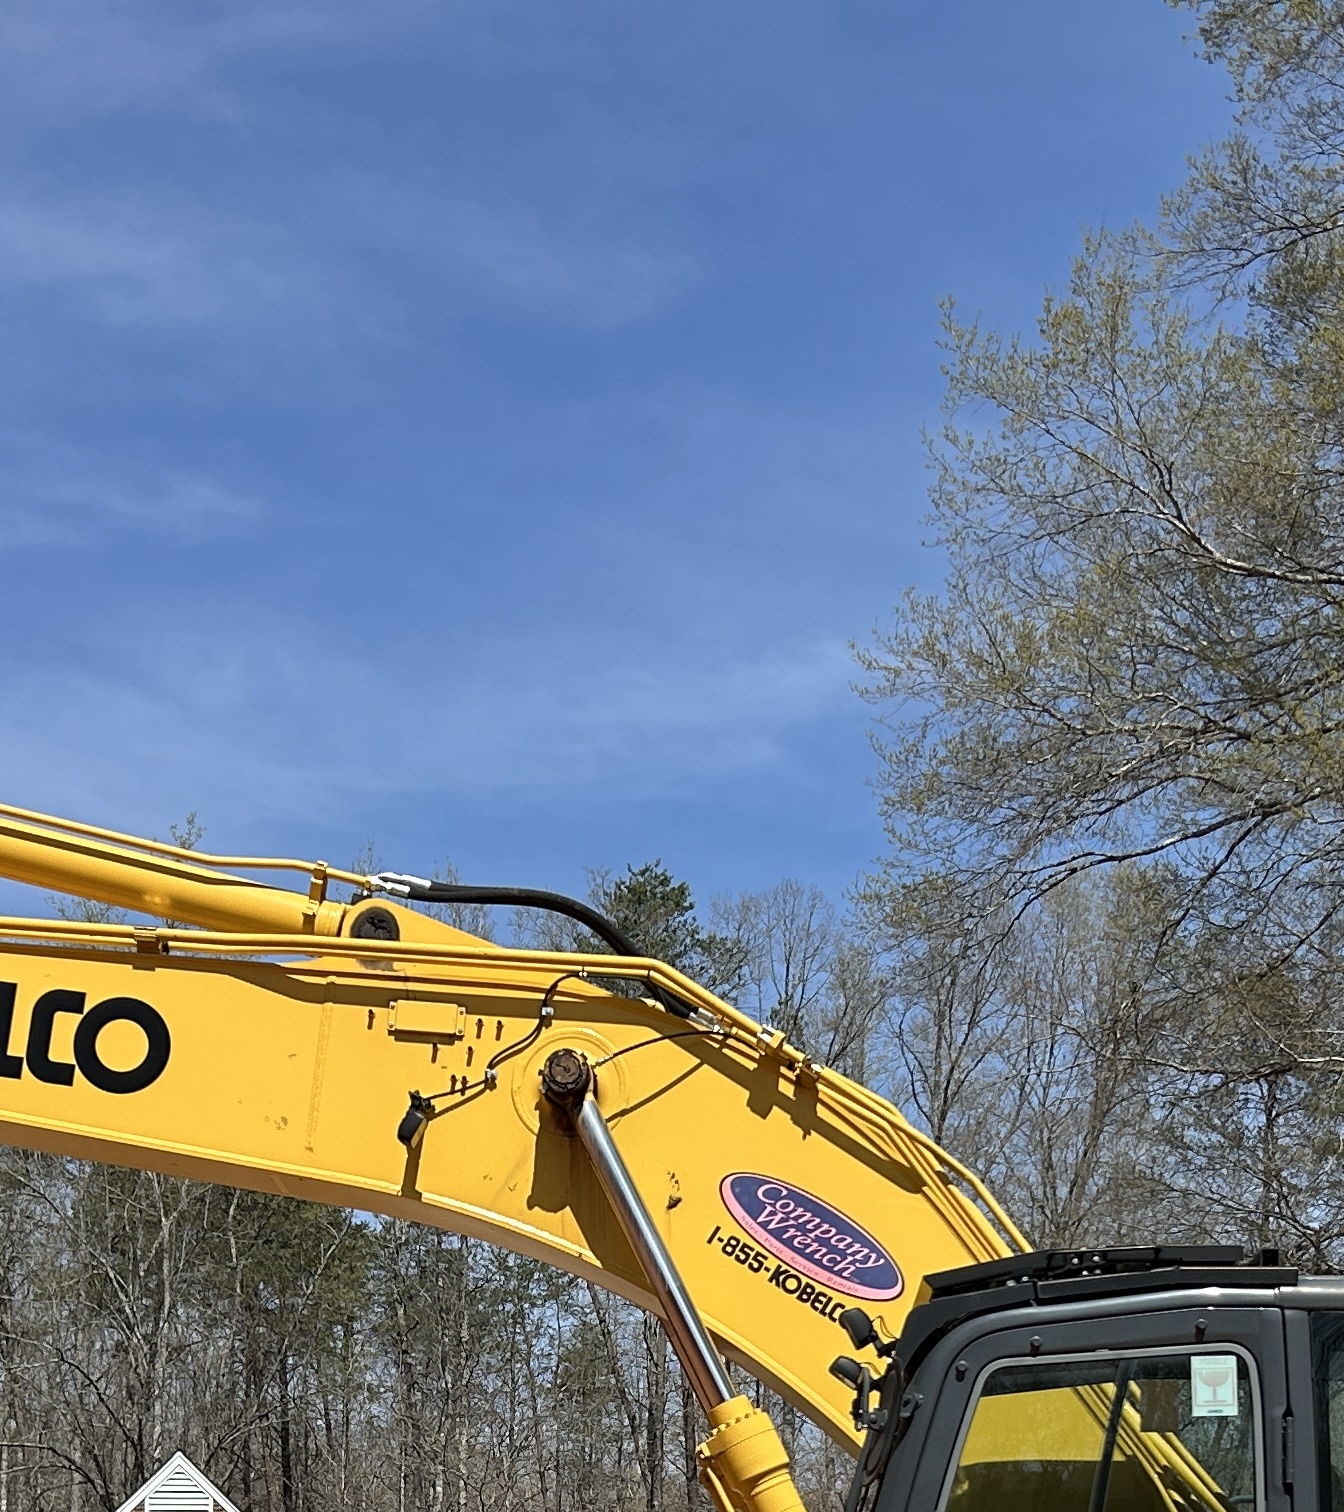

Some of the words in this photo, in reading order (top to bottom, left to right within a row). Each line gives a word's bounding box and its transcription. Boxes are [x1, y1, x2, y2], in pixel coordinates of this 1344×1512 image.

[756, 1203, 857, 1278] Wrench
[757, 1183, 885, 1268] Company
[706, 1225, 846, 1323] 1-855-KOBELC
